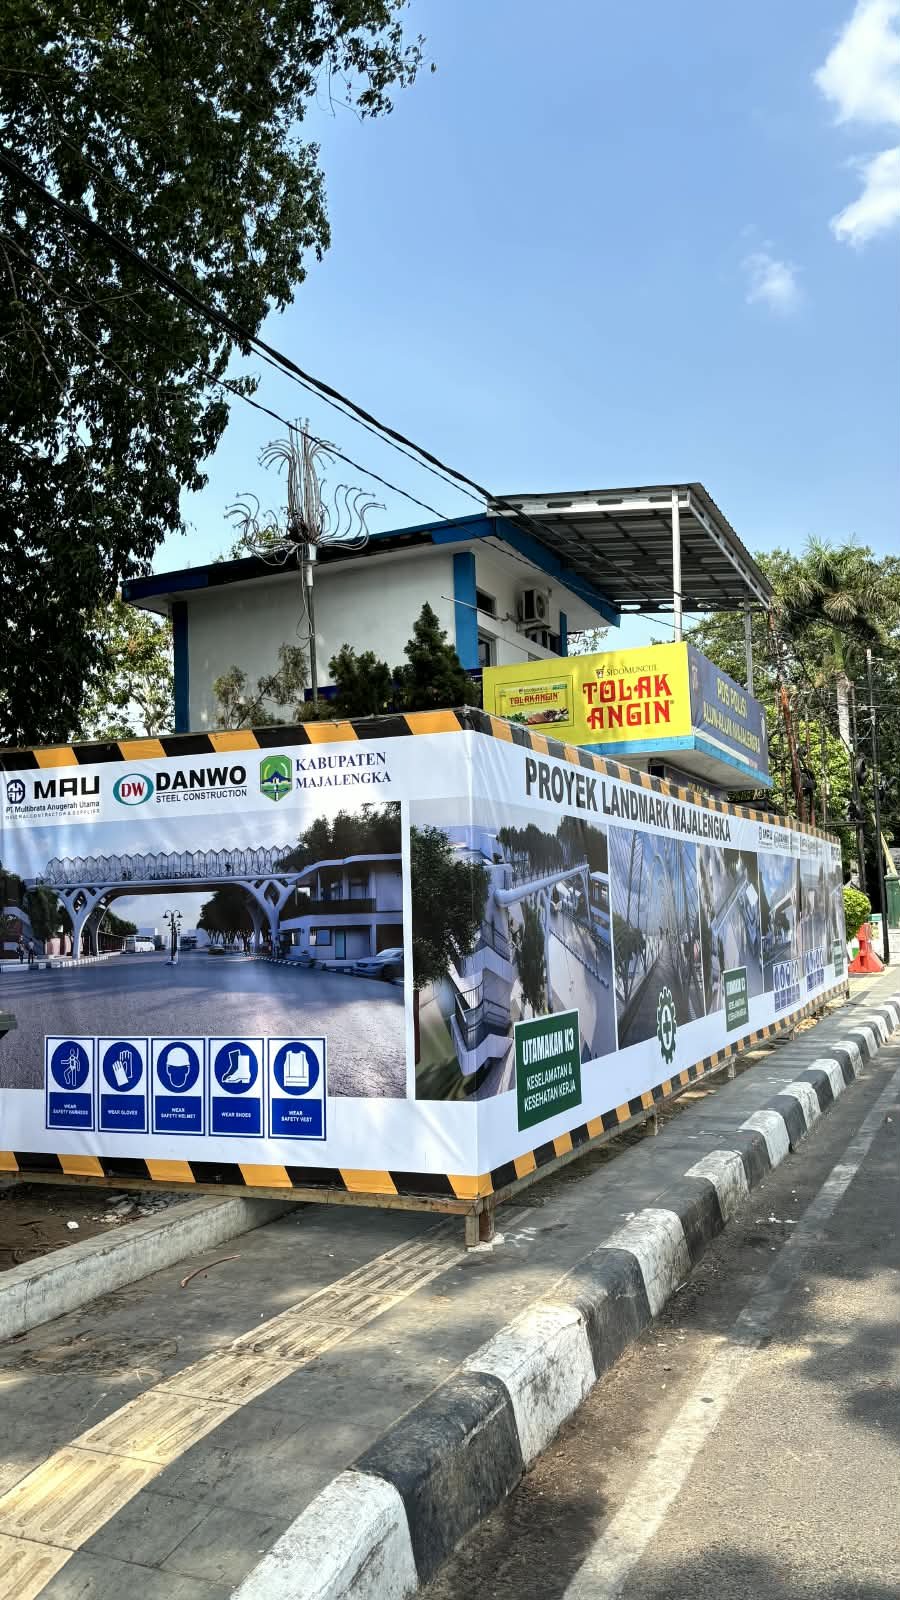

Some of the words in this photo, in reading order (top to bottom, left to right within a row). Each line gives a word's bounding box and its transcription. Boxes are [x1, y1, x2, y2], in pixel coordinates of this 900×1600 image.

[583, 674, 672, 704] TOLAK
[716, 677, 730, 706] POS
[587, 700, 671, 730] ANGIN
[295, 752, 387, 771] KABUPATEN
[34, 775, 100, 800] MAU
[121, 782, 145, 798] DW
[156, 765, 247, 791] DANWO
[296, 771, 392, 789] MAJALENGKA
[15, 805, 46, 813] Multibrata
[47, 802, 78, 811] Anugerah
[80, 801, 100, 809] Utama
[156, 793, 181, 803] STEEL
[183, 789, 247, 801] CONSTRUCTION
[525, 757, 598, 812] PROYEK
[601, 781, 671, 830] LANDMARK
[672, 804, 732, 842] MAJALENGKA
[522, 1030, 564, 1065] UTAMAKAN
[564, 1027, 574, 1052] K3
[527, 1064, 568, 1091] KESELAMATAN
[524, 1087, 558, 1112] KESEHATAN
[558, 1079, 576, 1097] KERJA
